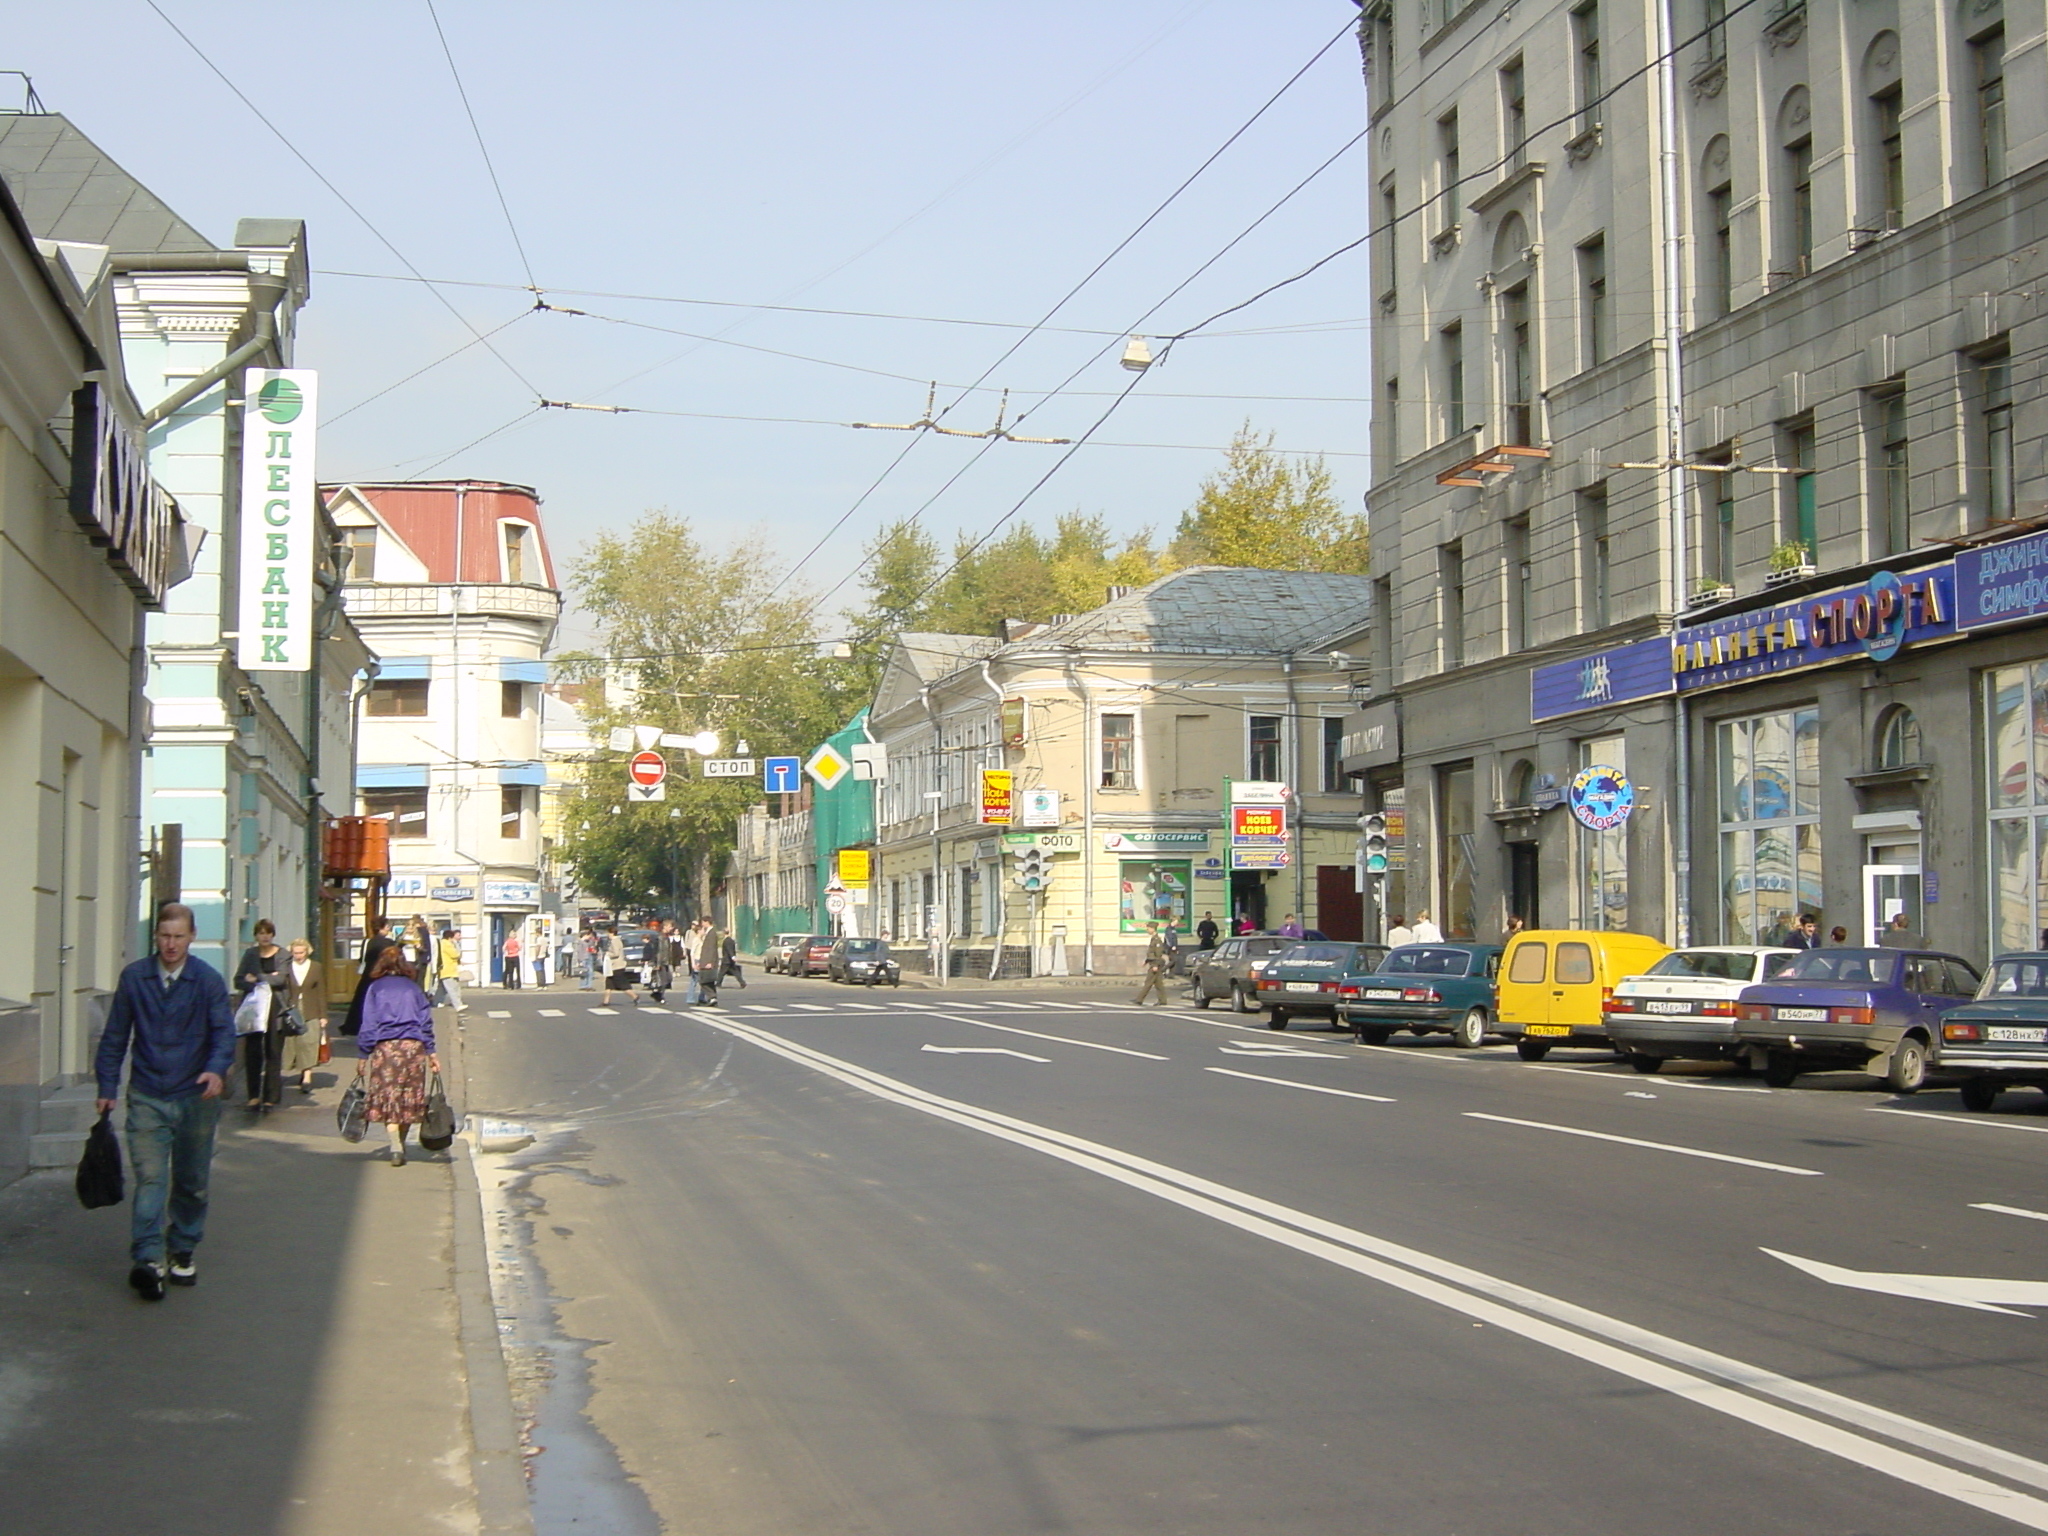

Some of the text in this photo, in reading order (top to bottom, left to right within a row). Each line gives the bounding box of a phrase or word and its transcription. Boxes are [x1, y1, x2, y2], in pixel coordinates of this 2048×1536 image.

[260, 430, 293, 664] ЛЕСБАНК
[1673, 577, 1942, 674] ПЛАНЕТА СПОРТА
[709, 761, 749, 774] СТОП
[1576, 804, 1631, 829] СПОРТА
[1239, 825, 1279, 835] КОВЧЕГ
[1041, 835, 1073, 847] ФОТО
[1134, 833, 1205, 841] ФОТОСЕРВИС
[831, 899, 842, 908] 20
